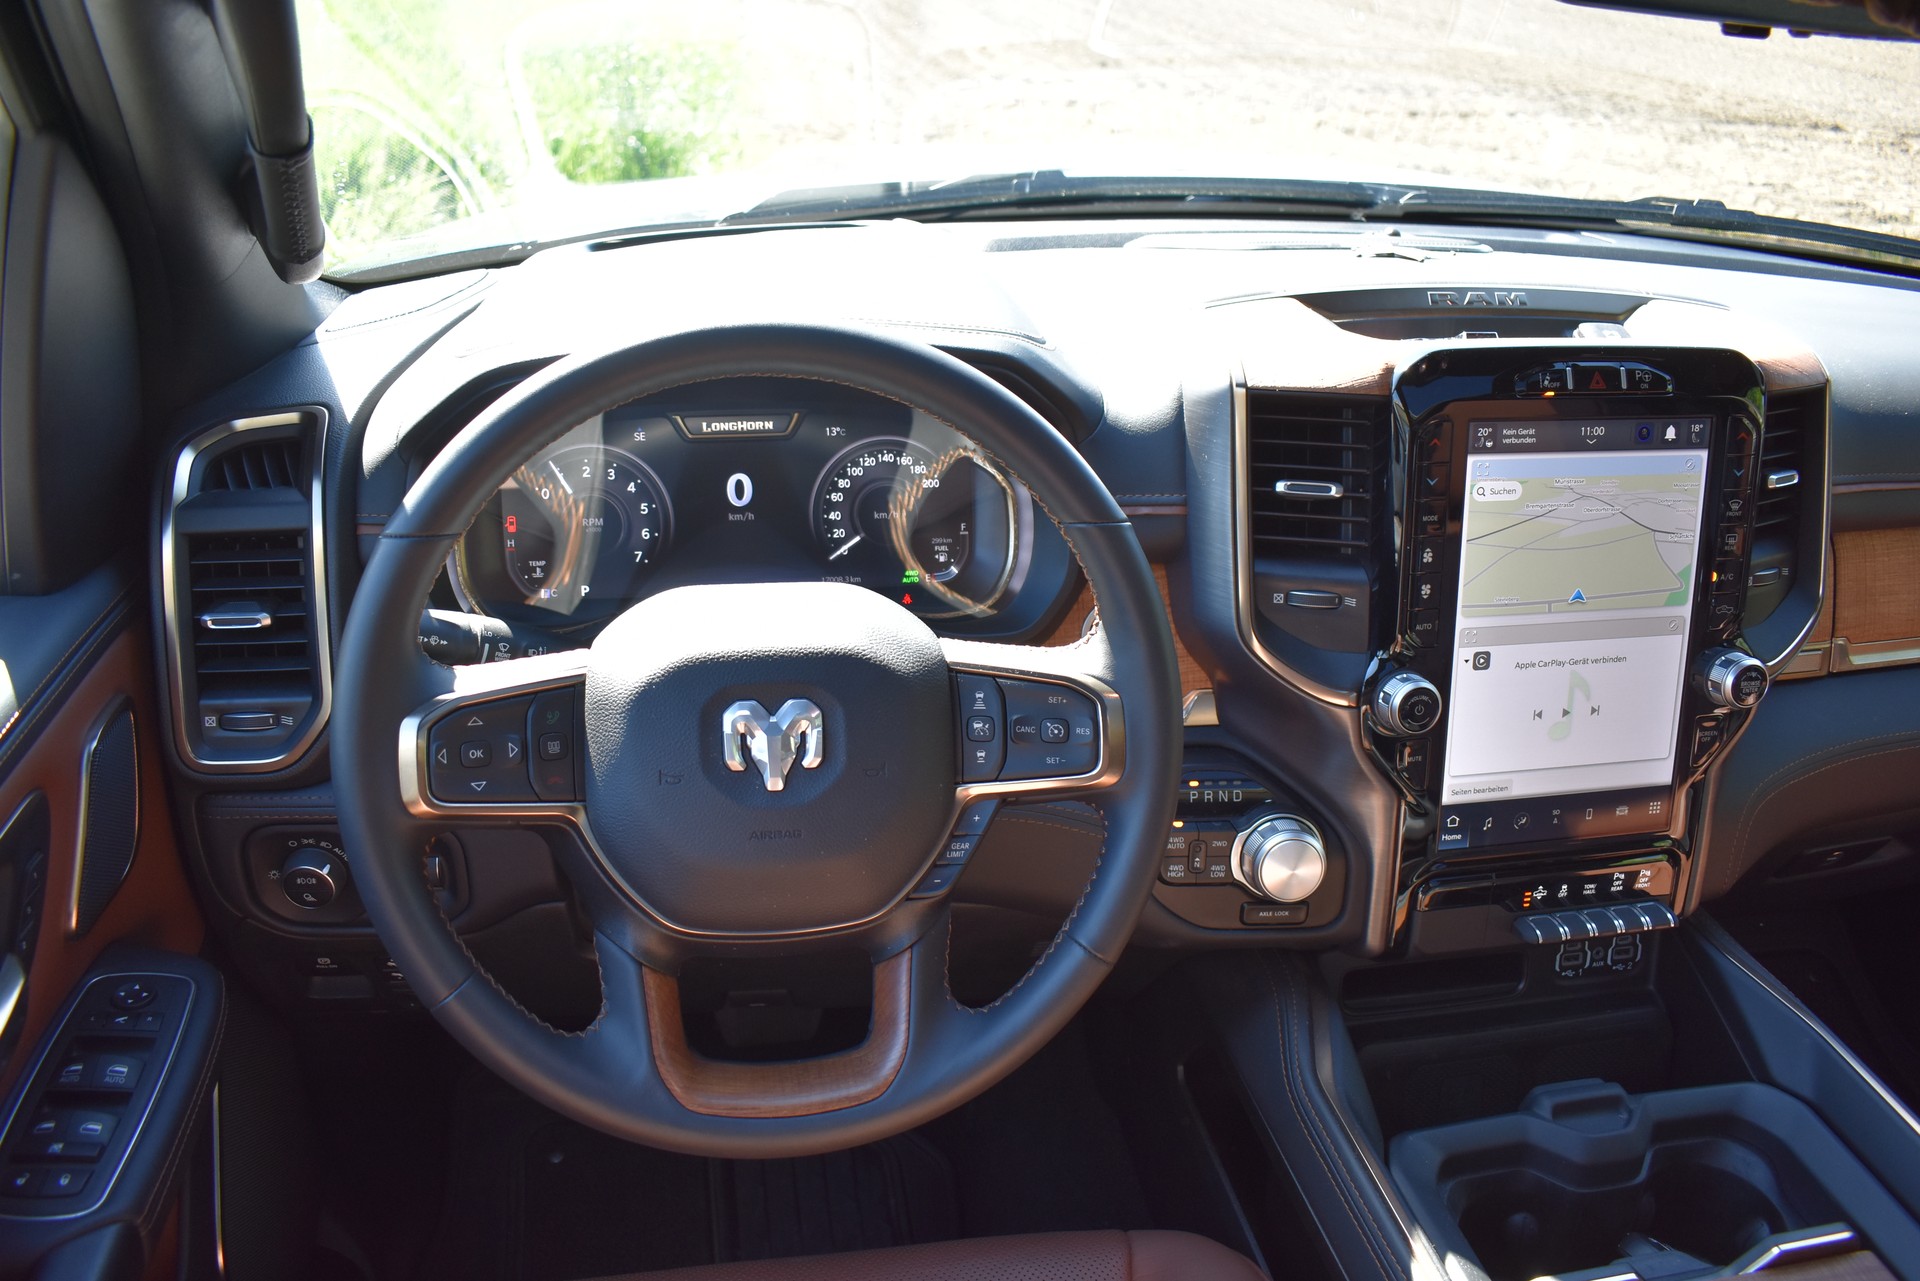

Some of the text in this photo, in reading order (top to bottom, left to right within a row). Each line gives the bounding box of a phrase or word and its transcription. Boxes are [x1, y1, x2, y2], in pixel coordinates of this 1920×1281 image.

[1427, 291, 1527, 306] RAM
[1502, 428, 1536, 436] Kein Gerät
[1581, 426, 1605, 436] 11:00
[634, 432, 646, 441] SE
[859, 457, 876, 466] 120
[877, 454, 894, 463] 140
[896, 457, 913, 466] 160
[582, 467, 591, 478] 2
[846, 468, 863, 476] 100
[910, 465, 926, 474] 180
[607, 469, 616, 480] 3
[627, 482, 636, 493] 4
[838, 479, 851, 489] 80
[922, 479, 940, 488] 200
[541, 488, 550, 500] 0
[726, 472, 753, 507] 0
[1489, 487, 1517, 496] Suchen
[830, 493, 844, 502] 60
[640, 503, 649, 514] 5
[728, 513, 755, 522] km/h
[828, 511, 842, 521] 40
[582, 518, 604, 527] RPM
[961, 523, 967, 531] F
[641, 529, 650, 540] 6
[833, 529, 846, 538] 20
[507, 539, 515, 548] H
[634, 552, 643, 563] 7
[581, 586, 590, 597] P
[1415, 623, 1432, 631] AUTO
[1514, 655, 1627, 670] Apple CarPlay-Gerät verbinden
[1015, 725, 1036, 734] CANC
[1075, 727, 1091, 735] RES
[469, 749, 485, 759] OK
[1451, 785, 1509, 796] Seiten bearbeiten
[749, 829, 803, 842] AIRBAG
[1441, 833, 1462, 841] Home
[951, 842, 970, 850] GEAR
[946, 850, 965, 858] LIMIT
[104, 1075, 126, 1084] AUTO
